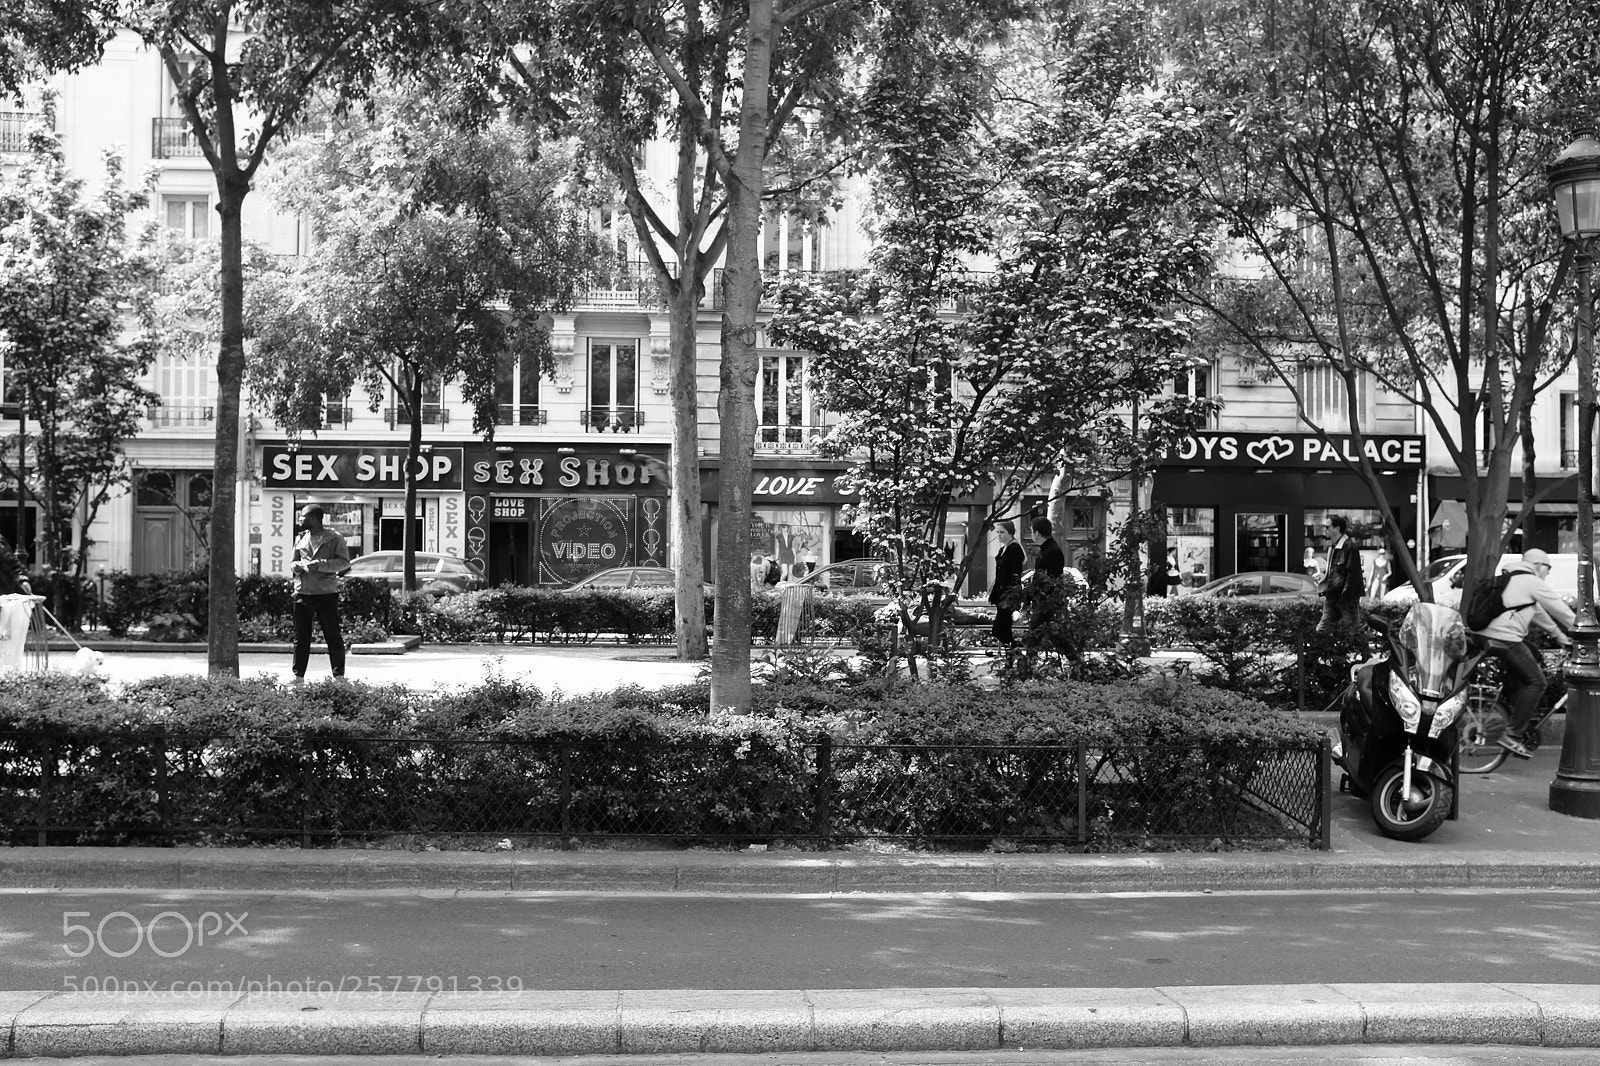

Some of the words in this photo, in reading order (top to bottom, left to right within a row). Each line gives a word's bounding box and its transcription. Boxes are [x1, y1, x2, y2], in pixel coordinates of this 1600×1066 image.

[1157, 436, 1238, 460] OYS
[1303, 438, 1421, 463] PALACE
[272, 453, 339, 481] SEX
[355, 455, 452, 482] SHOP
[473, 458, 544, 485] SEX
[753, 476, 825, 495] LOVE
[271, 496, 284, 537] SEX
[494, 508, 525, 517] SHOP
[495, 499, 525, 507] LOVE
[445, 497, 458, 538] SEX
[551, 542, 617, 559] VIDEO
